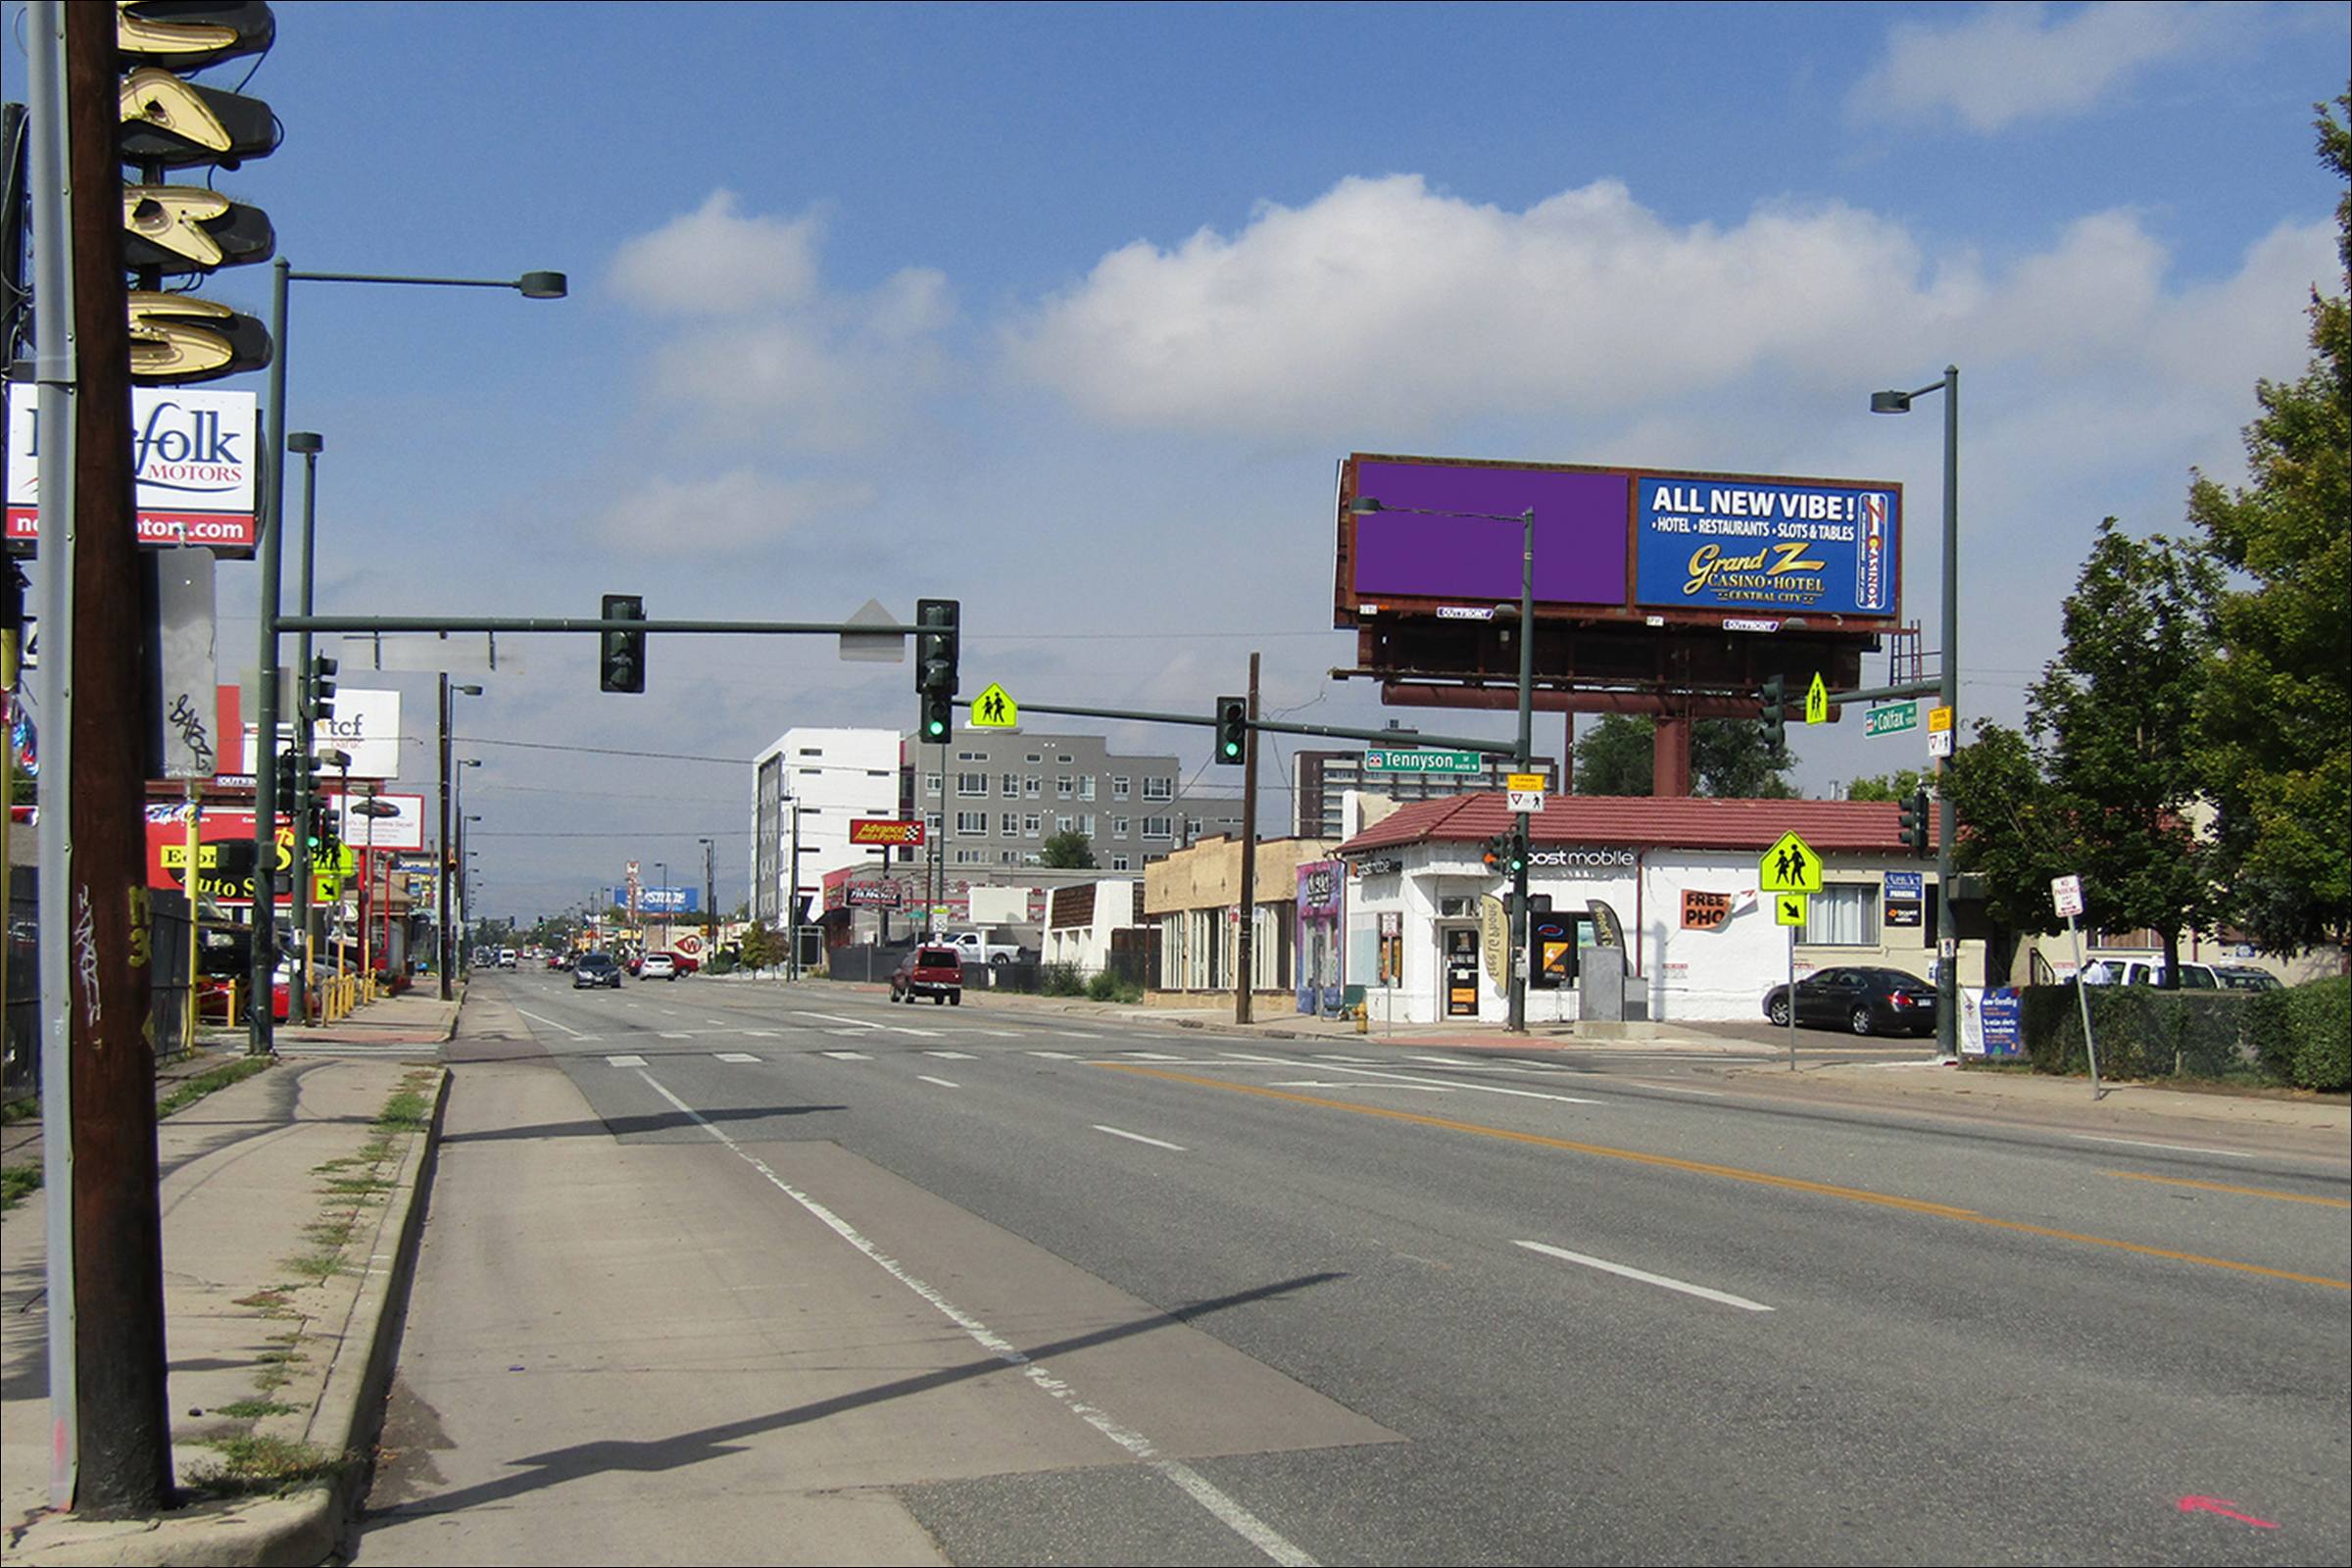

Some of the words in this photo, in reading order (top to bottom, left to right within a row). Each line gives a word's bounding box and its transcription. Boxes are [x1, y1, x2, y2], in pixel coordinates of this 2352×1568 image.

[147, 464, 243, 482] MOTORS
[1652, 486, 1705, 514] ALL
[1710, 489, 1776, 516] NEW
[1657, 516, 1690, 533] HOTEL
[1698, 518, 1770, 537] RESTAURANTS
[1777, 522, 1808, 539] SLOTS
[1809, 524, 1818, 539] &
[1818, 525, 1855, 541] TABLES
[1683, 544, 1768, 595] Grand
[1765, 542, 1826, 576] Z
[1707, 573, 1766, 589] CASINO
[1774, 576, 1826, 592] HOTEL
[1729, 590, 1777, 602] CENTRAL
[1778, 593, 1801, 603] CITY
[328, 713, 364, 735] tcf
[1878, 710, 1904, 731] Colfax
[1385, 753, 1453, 771] Tennyson
[861, 823, 904, 834] Advance
[1687, 894, 1724, 906] FREE
[1686, 909, 1726, 925] PHO
